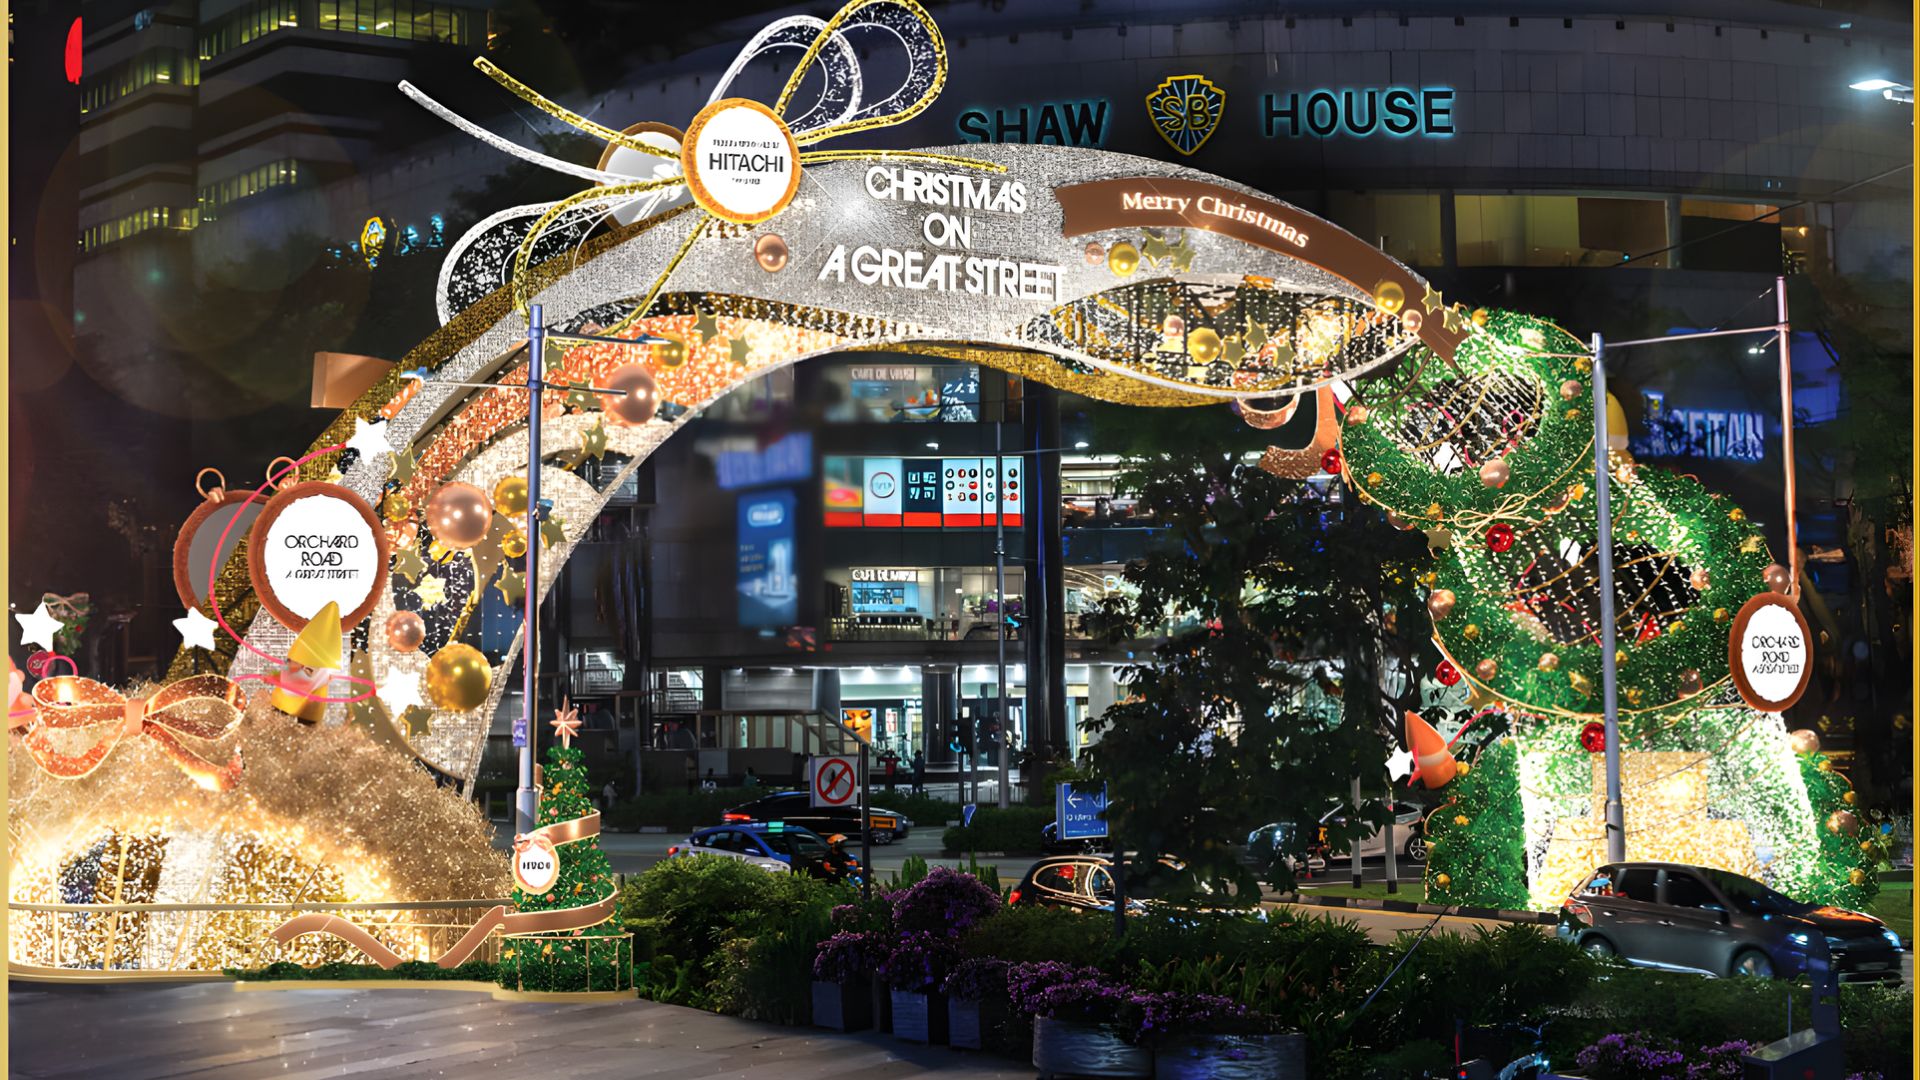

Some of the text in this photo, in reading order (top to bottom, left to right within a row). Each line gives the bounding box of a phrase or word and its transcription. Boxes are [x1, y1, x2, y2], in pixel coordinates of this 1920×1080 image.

[957, 89, 1455, 144] SHAW HOUSE
[1161, 94, 1211, 131] SB
[709, 153, 783, 172] HITACHI
[864, 165, 1026, 214] CHRISTMAS
[923, 211, 971, 249] ON
[1122, 192, 1310, 248] Merry Christmas
[817, 244, 1068, 304] A GREAT STREET
[284, 535, 359, 549] ORCHARD
[301, 551, 343, 567] ROAD
